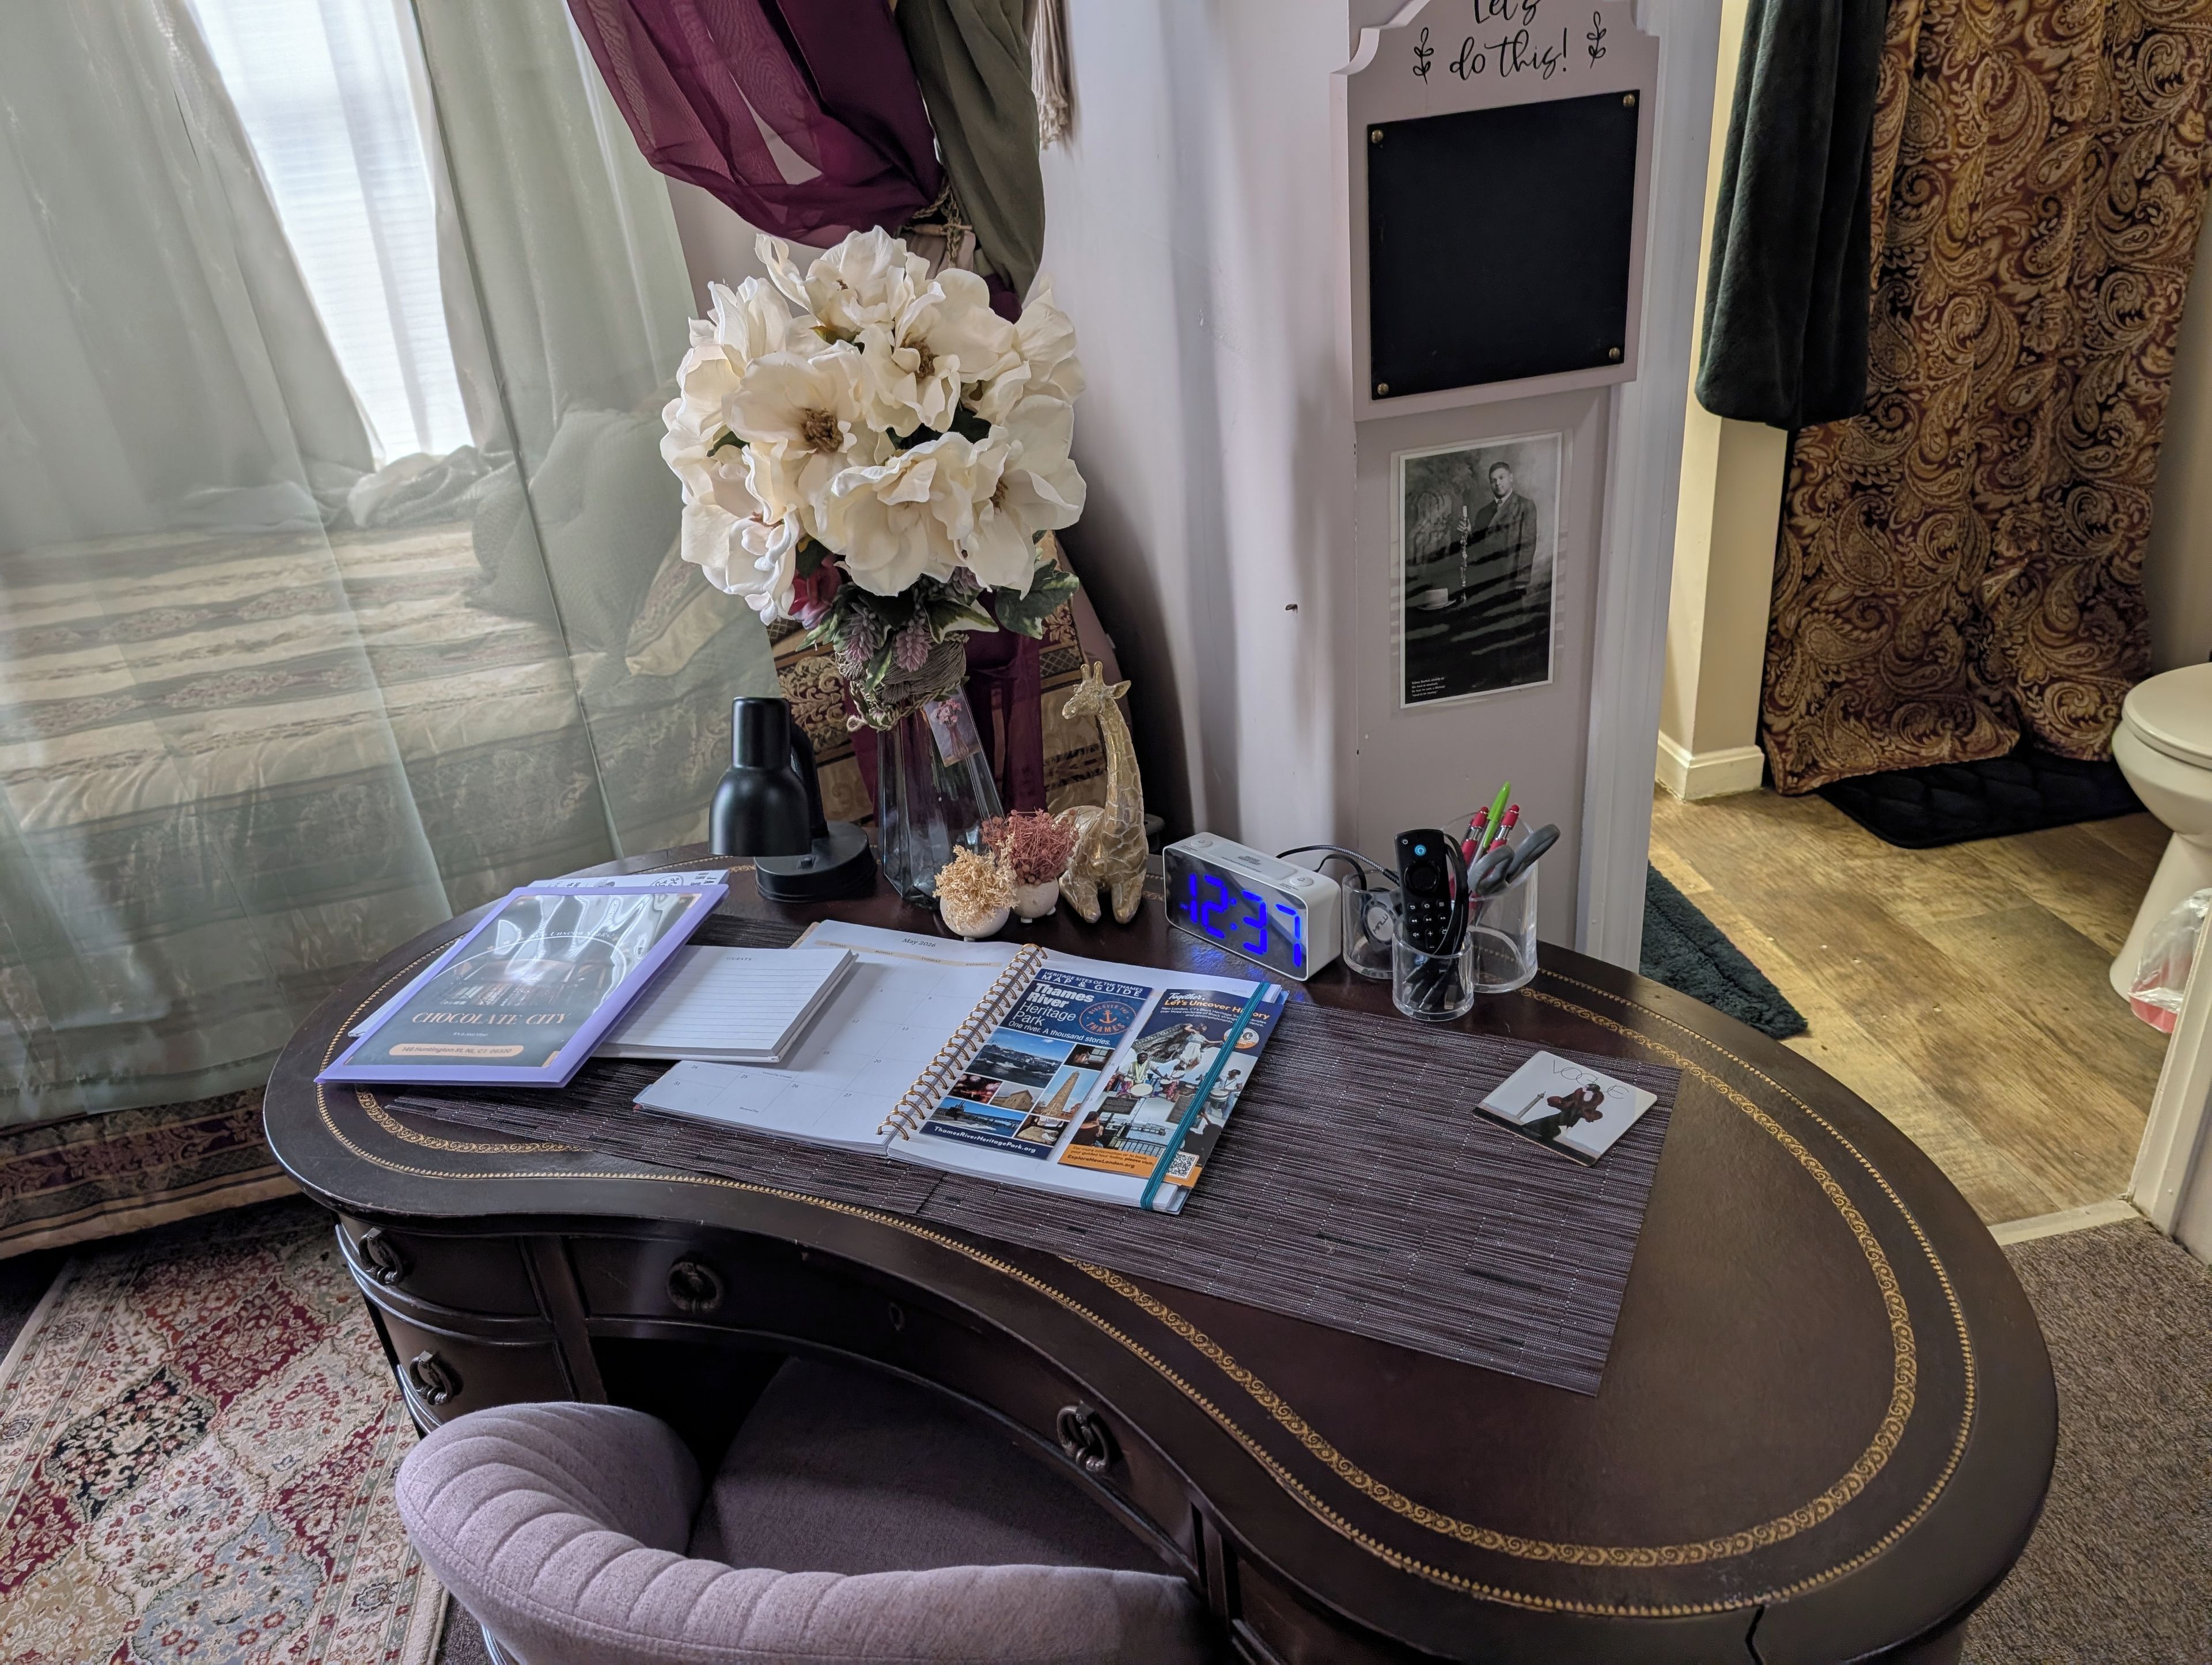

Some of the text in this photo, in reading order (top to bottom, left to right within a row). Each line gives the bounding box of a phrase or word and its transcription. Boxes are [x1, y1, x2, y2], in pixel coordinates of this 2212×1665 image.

[1449, 28, 1567, 80] do this!
[1189, 873, 1302, 968] 12:37
[1041, 974, 1071, 983] MAP
[1094, 985, 1140, 997] GUIDE
[1045, 971, 1075, 980] HERITAGE
[1117, 984, 1143, 992] THAMES
[1027, 992, 1070, 1008] River
[1036, 983, 1094, 1003] Thames
[412, 1012, 571, 1025] CHOCOLATE CITY
[1013, 1011, 1046, 1027] Park
[1020, 1001, 1077, 1022] Heritage
[1189, 1000, 1231, 1010] Uncover
[1232, 1007, 1270, 1020] Hiory
[1009, 1021, 1023, 1029] One
[1024, 1025, 1041, 1034] river.
[1050, 1030, 1084, 1041] thousand
[1085, 1036, 1111, 1046] stories.
[1086, 1022, 1126, 1033] THAMES
[934, 1126, 1037, 1153] ThamesRiverHeritagePark.org
[1067, 1154, 1135, 1169] ExploreNewLondon.org
